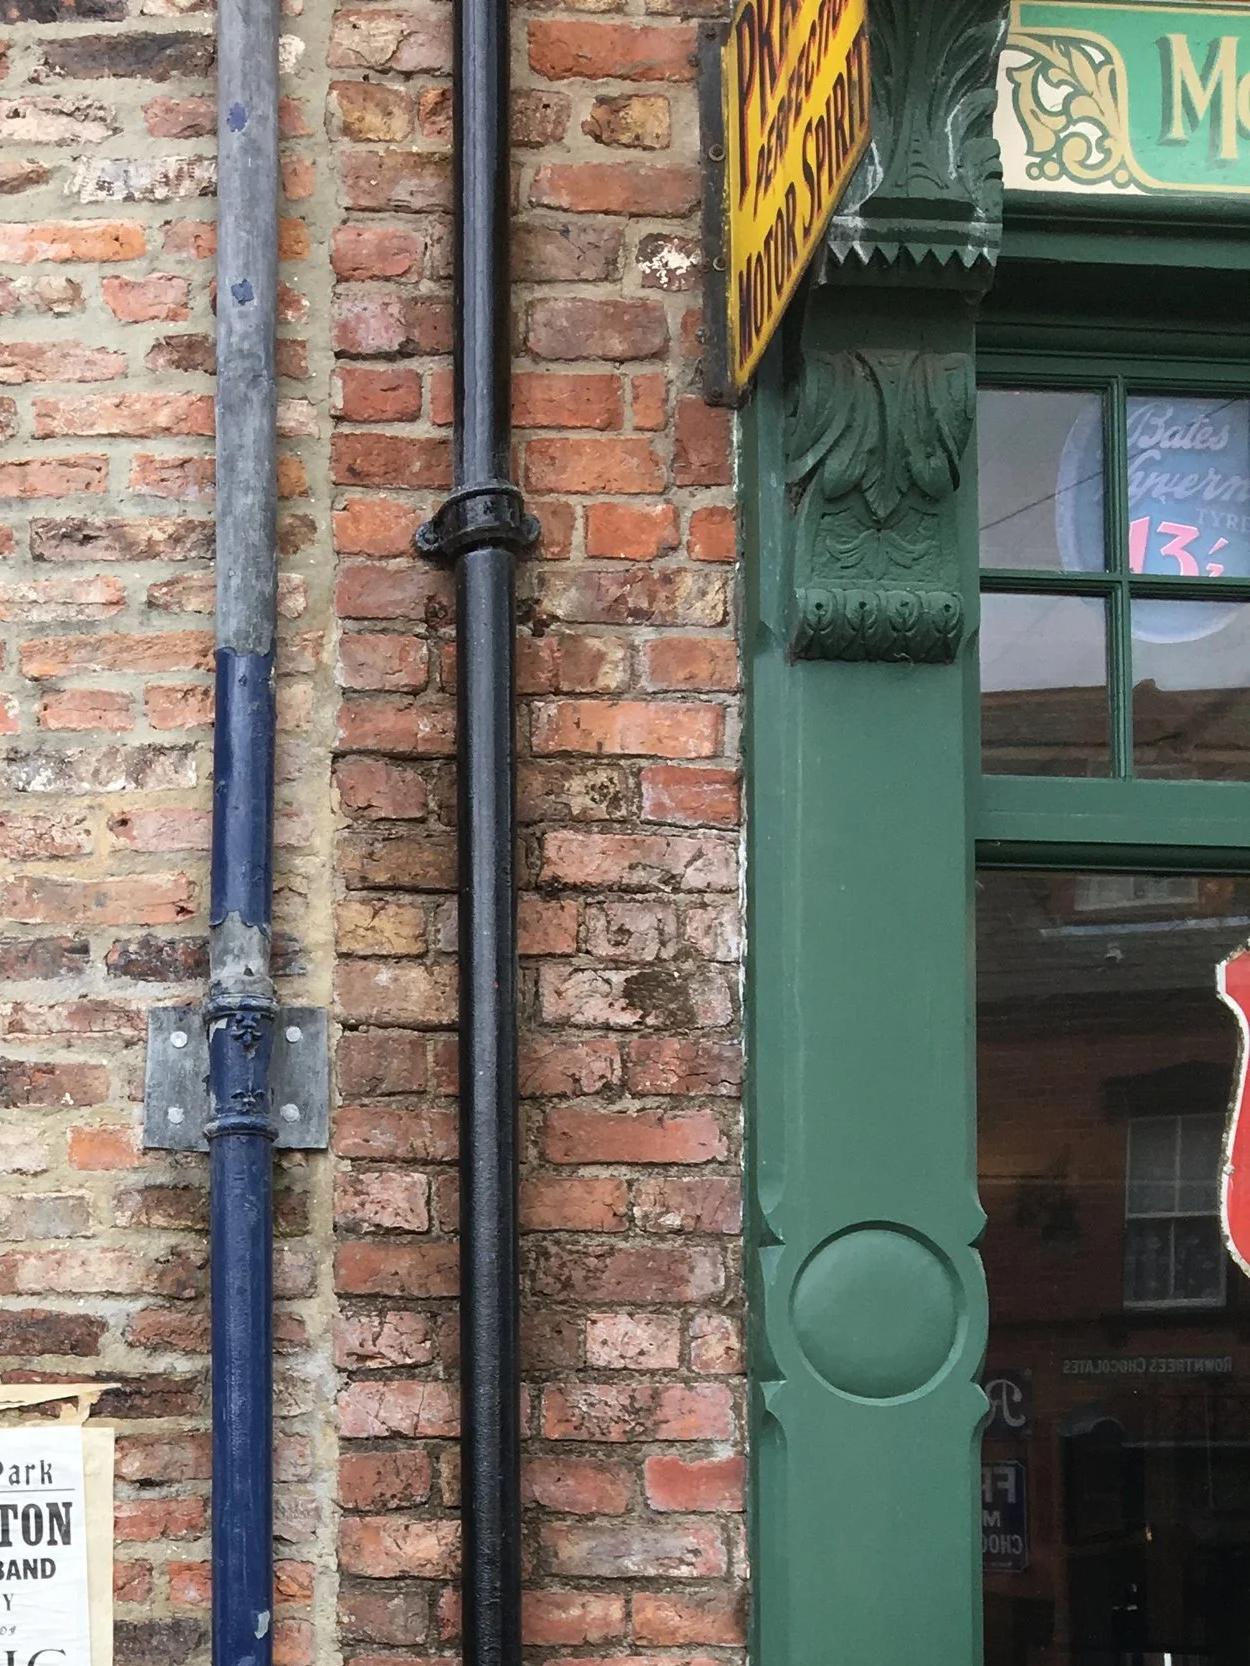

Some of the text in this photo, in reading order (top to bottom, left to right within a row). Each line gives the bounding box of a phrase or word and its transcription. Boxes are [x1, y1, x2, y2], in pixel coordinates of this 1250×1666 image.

[739, 20, 869, 372] MOTOR SPIRIT
[1127, 402, 1230, 451] Bates
